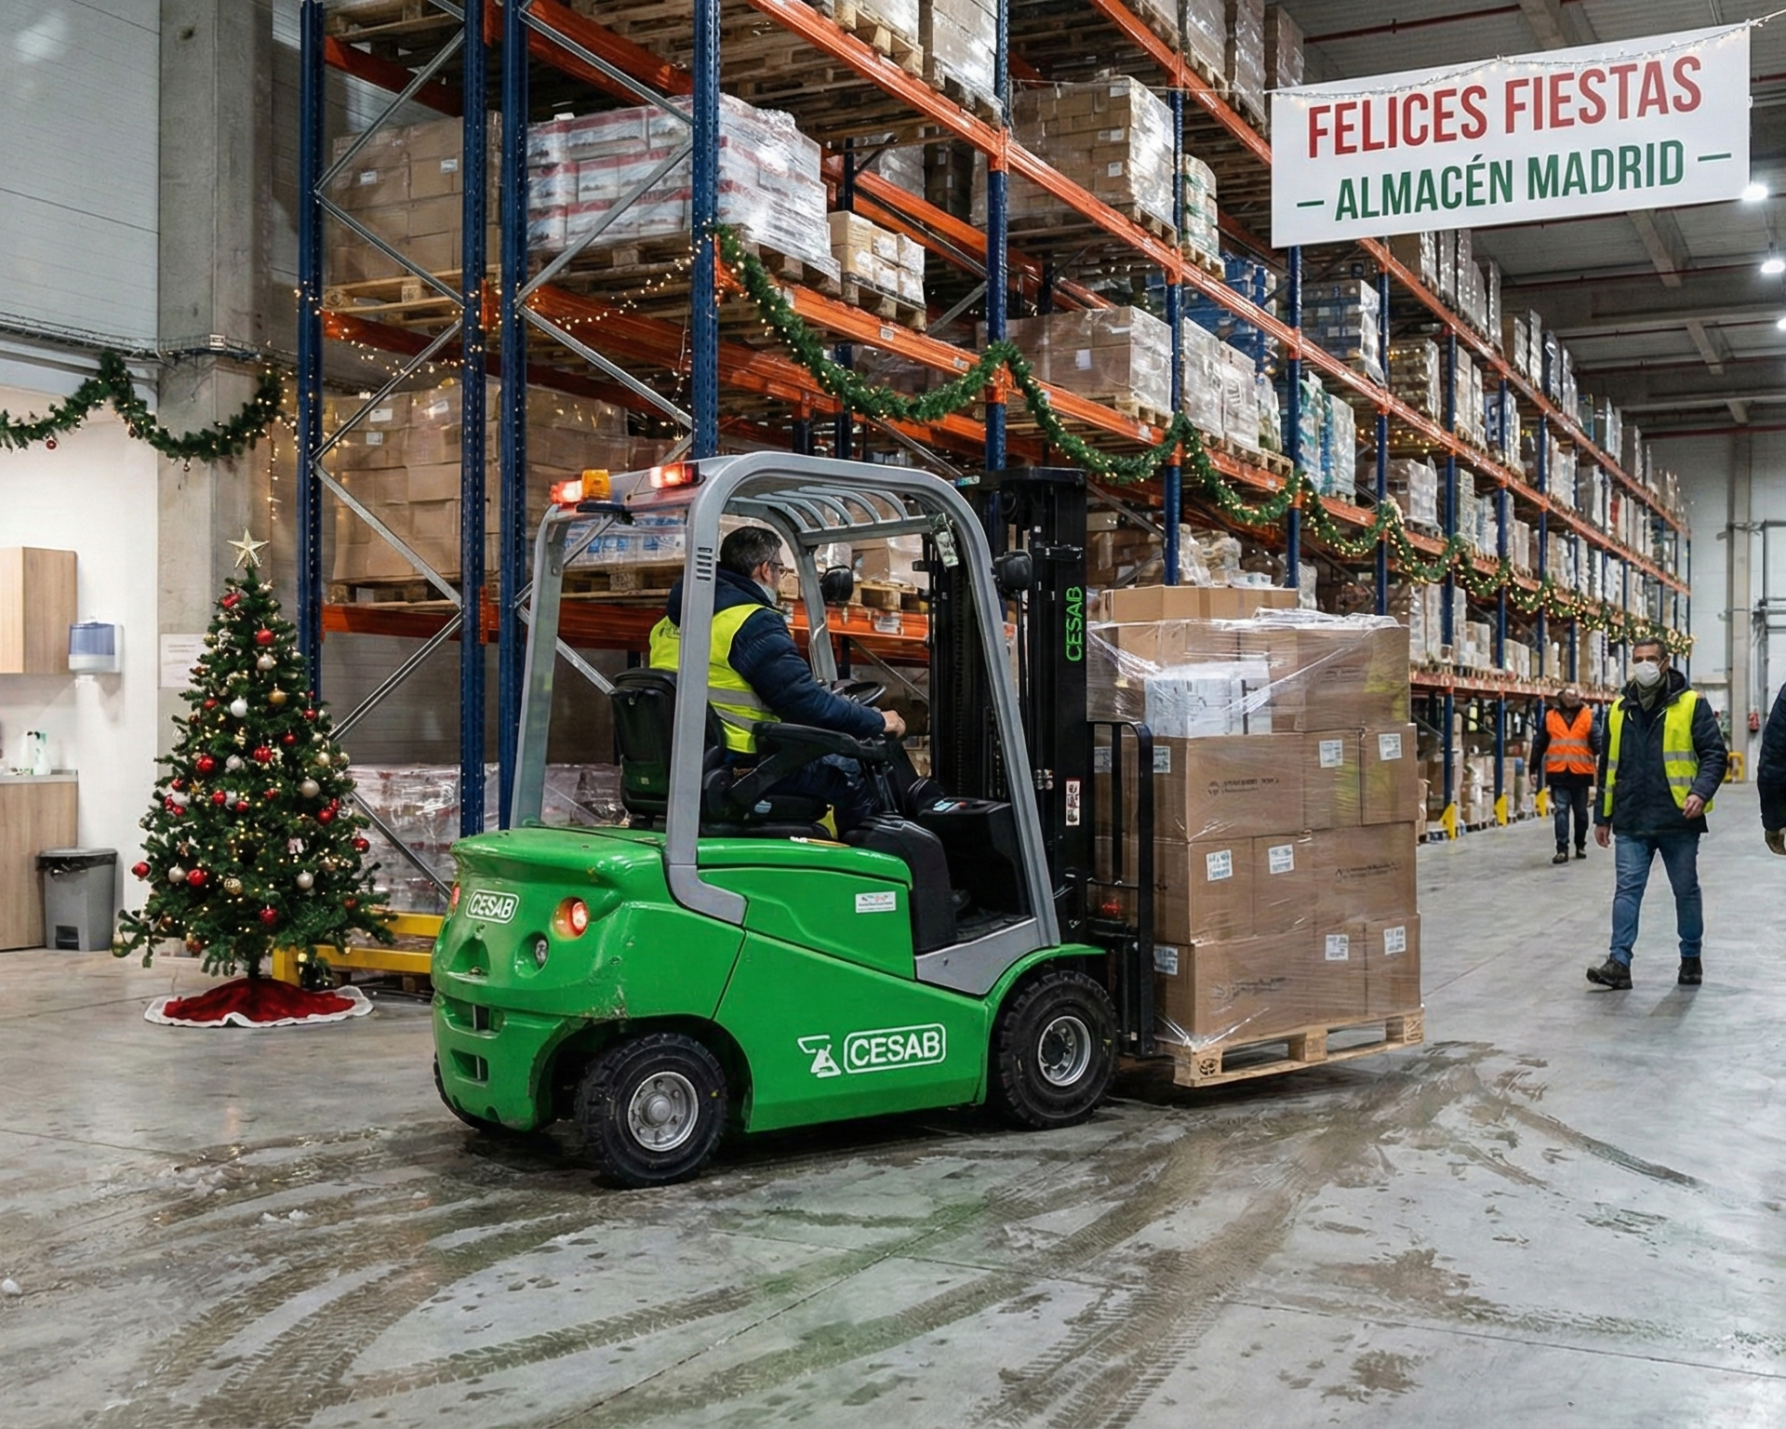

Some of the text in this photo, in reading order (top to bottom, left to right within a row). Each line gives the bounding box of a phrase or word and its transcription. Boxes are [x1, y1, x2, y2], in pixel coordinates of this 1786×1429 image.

[1307, 55, 1702, 159] FELICES FIESTAS
[1335, 139, 1684, 222] ALMACÉN MADRID
[1066, 586, 1083, 662] CESAB
[470, 893, 515, 919] CESAB
[850, 1031, 941, 1067] CESAB
